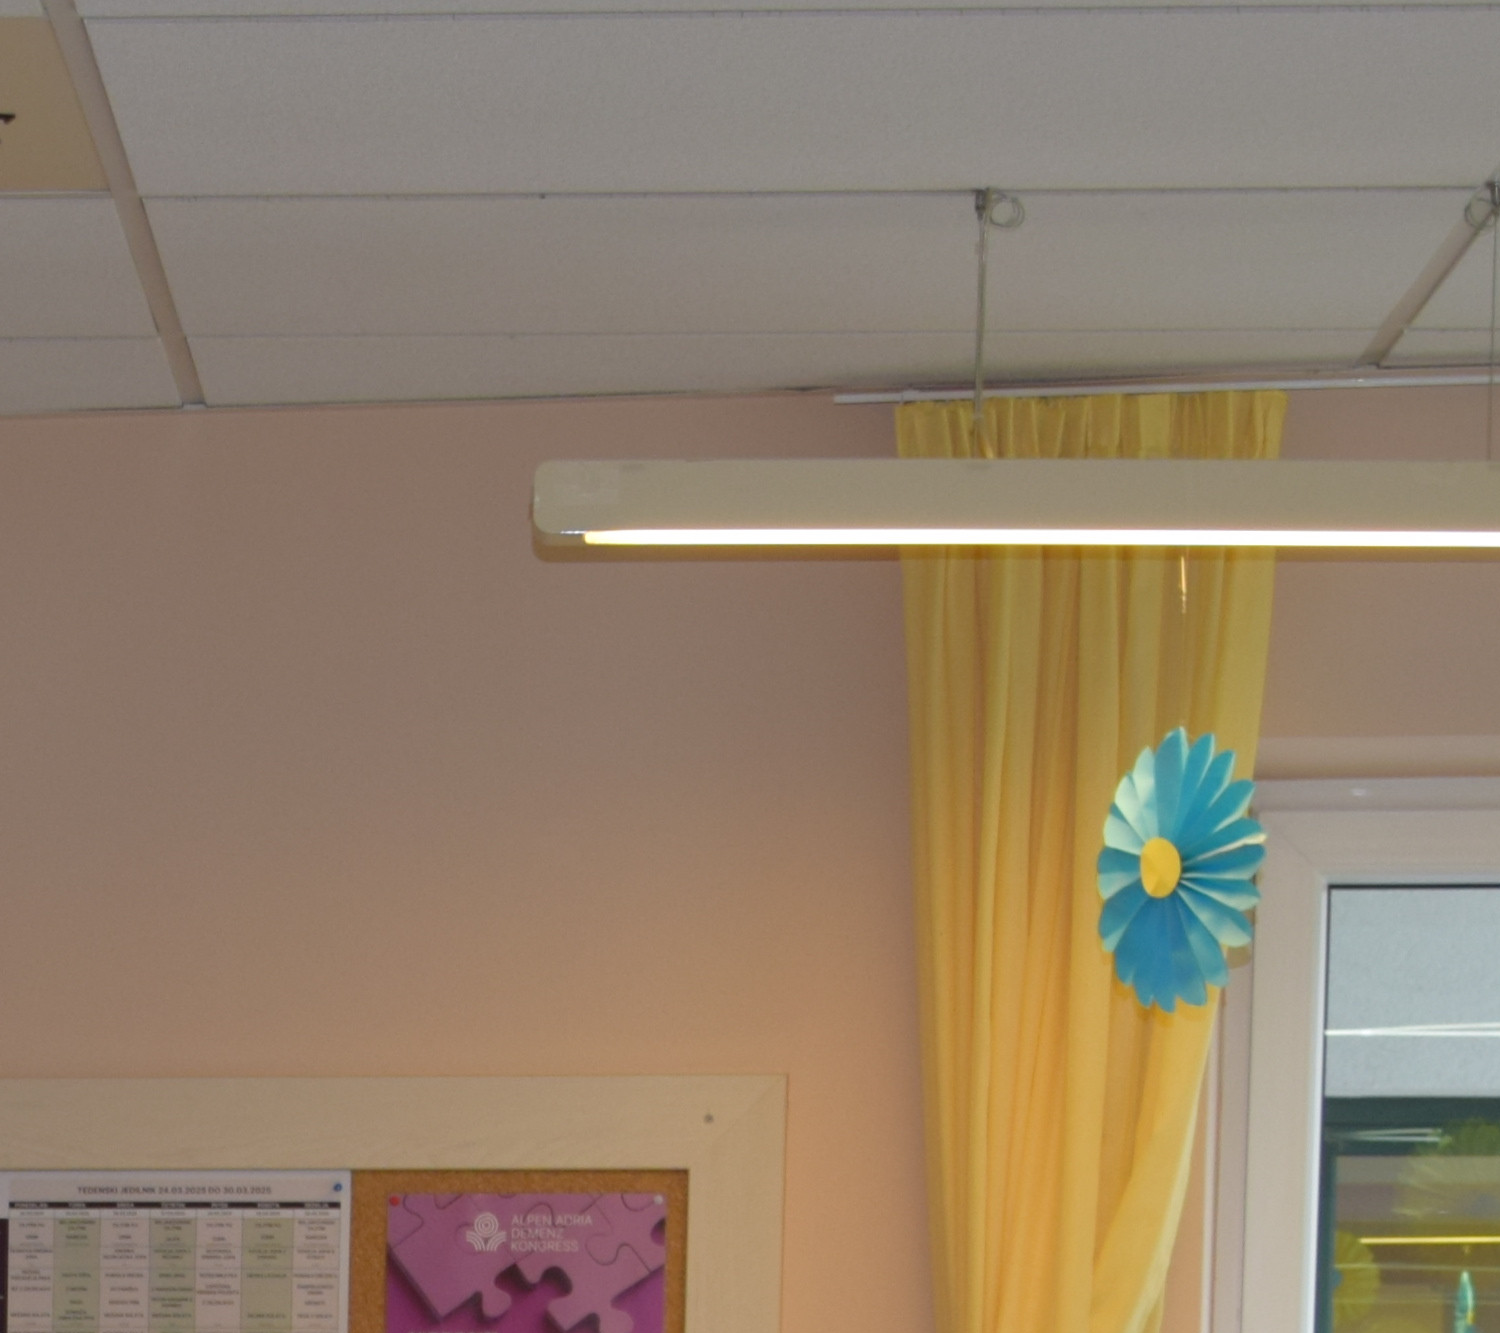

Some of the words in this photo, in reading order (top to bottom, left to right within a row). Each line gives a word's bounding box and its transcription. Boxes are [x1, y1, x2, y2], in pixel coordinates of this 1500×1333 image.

[512, 1214, 552, 1225] ALPEN
[557, 1214, 592, 1226] ADRIA
[512, 1228, 564, 1239] DEMENZ
[511, 1240, 578, 1252] KONGRESS
